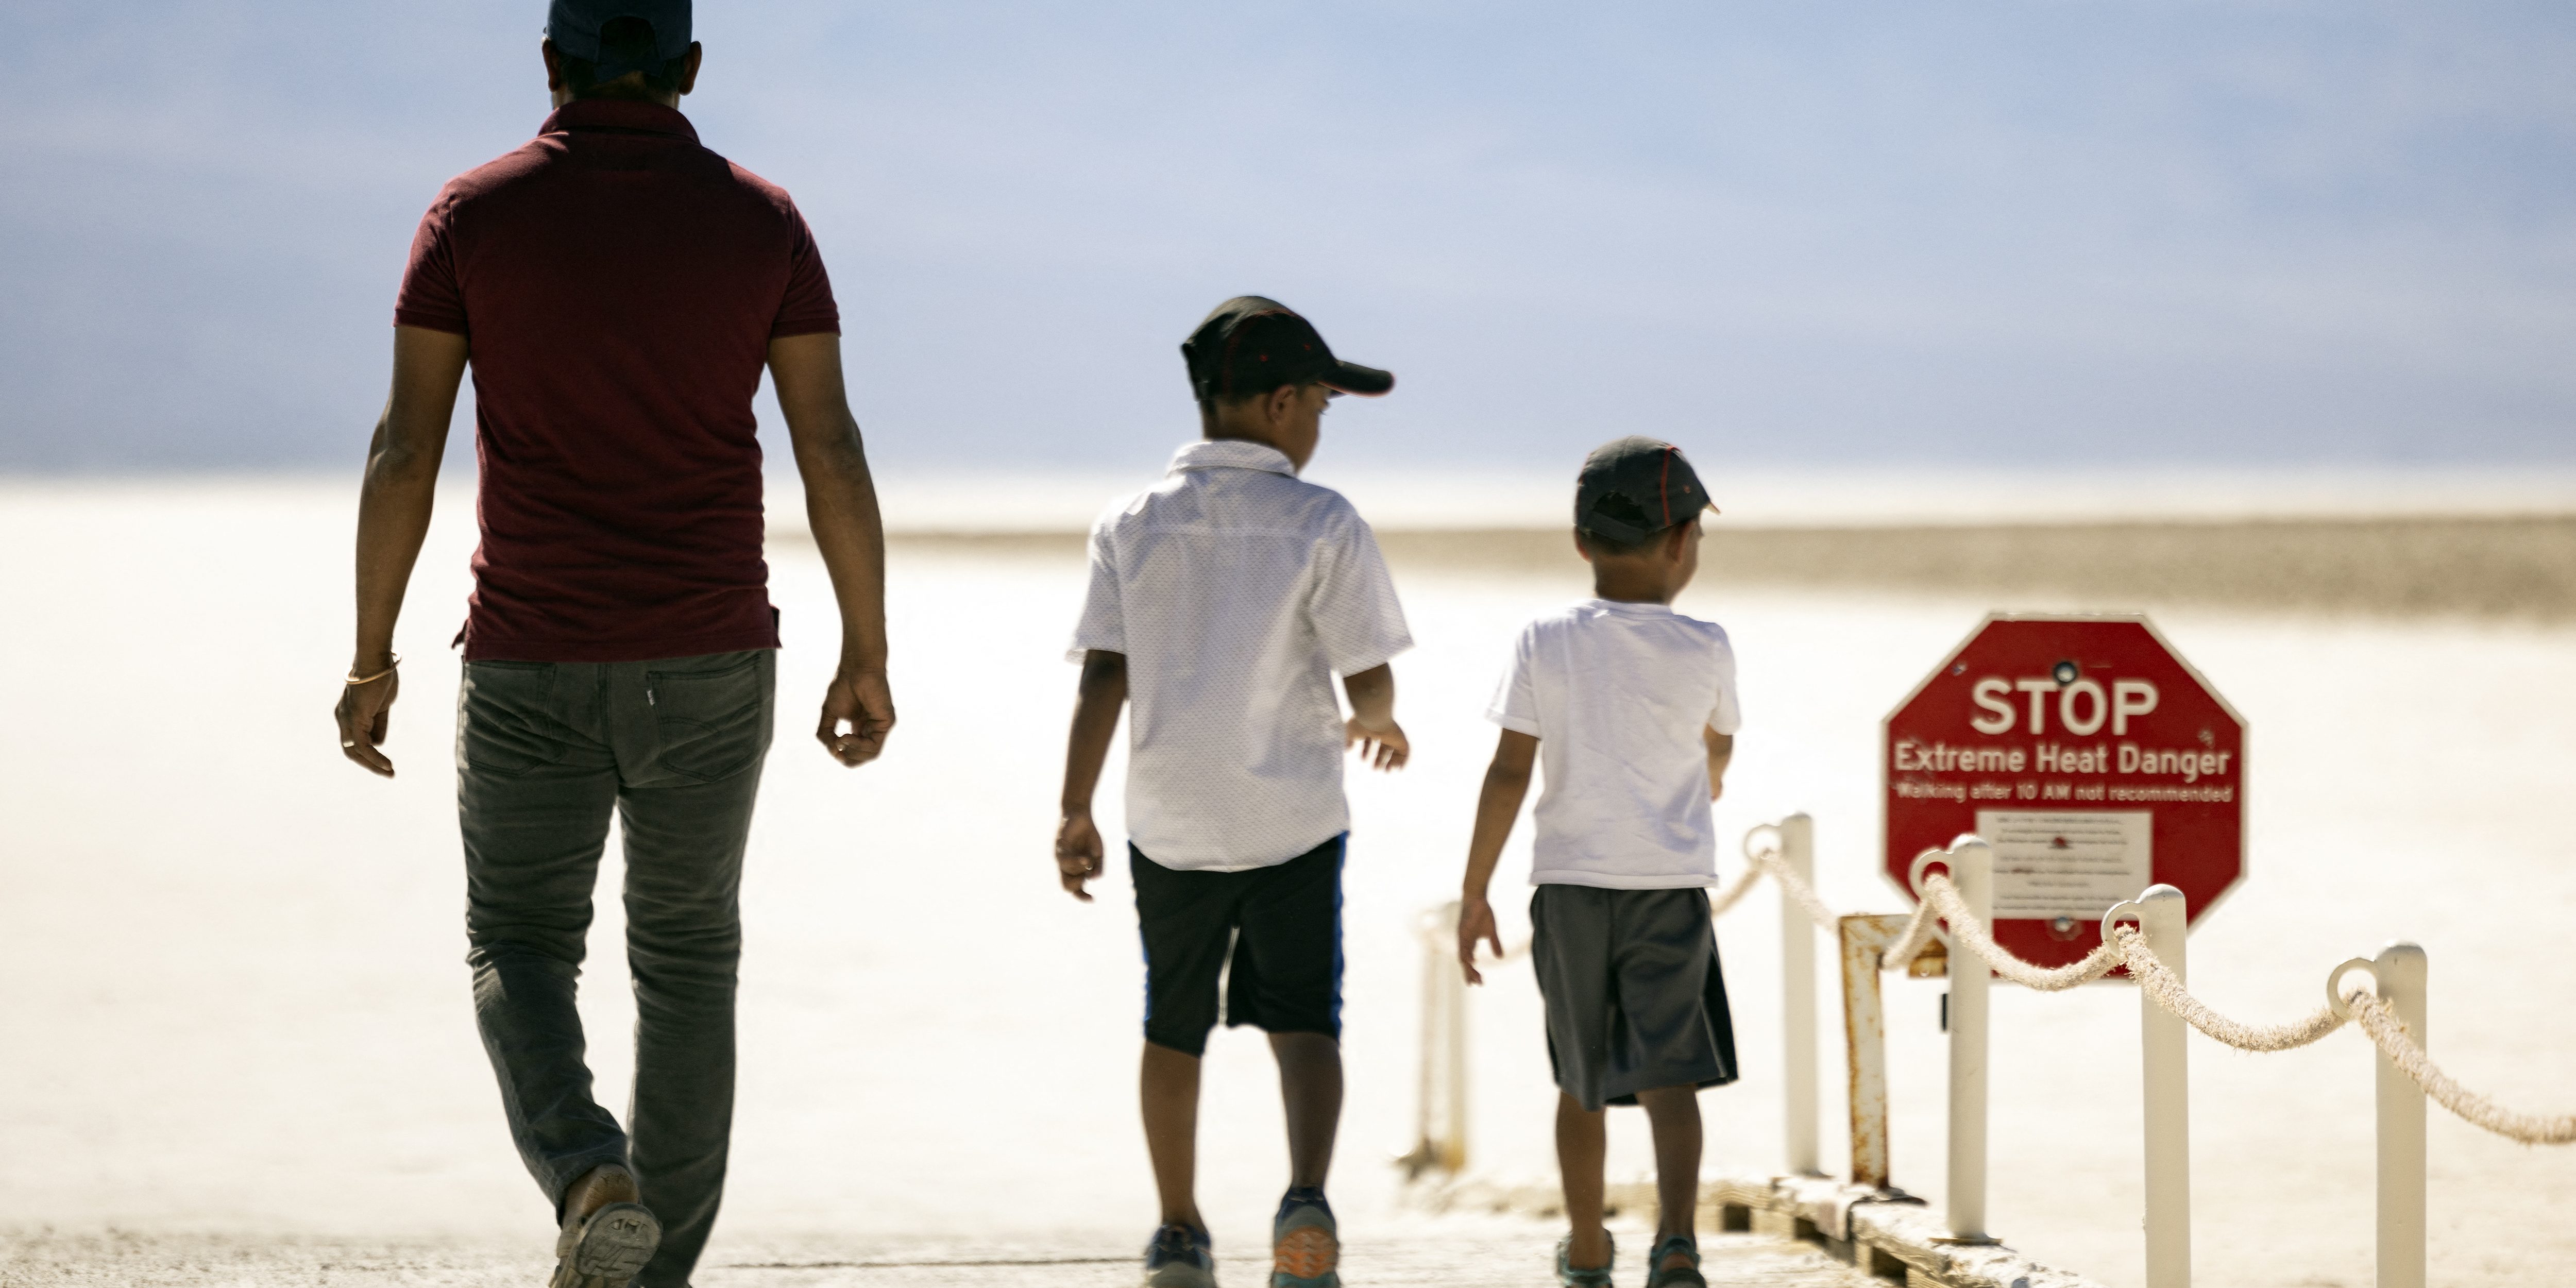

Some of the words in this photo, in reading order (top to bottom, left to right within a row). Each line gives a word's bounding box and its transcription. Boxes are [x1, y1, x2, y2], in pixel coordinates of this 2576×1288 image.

[1970, 680, 2160, 736] STOP
[1894, 743, 2025, 773] Extreme
[2036, 744, 2108, 774] Heat
[2119, 745, 2232, 783] Danger
[1970, 783, 2012, 799] after
[2016, 784, 2035, 800] 10
[2042, 785, 2071, 800] AM
[2075, 784, 2105, 801] not
[2108, 785, 2233, 803] recommended
